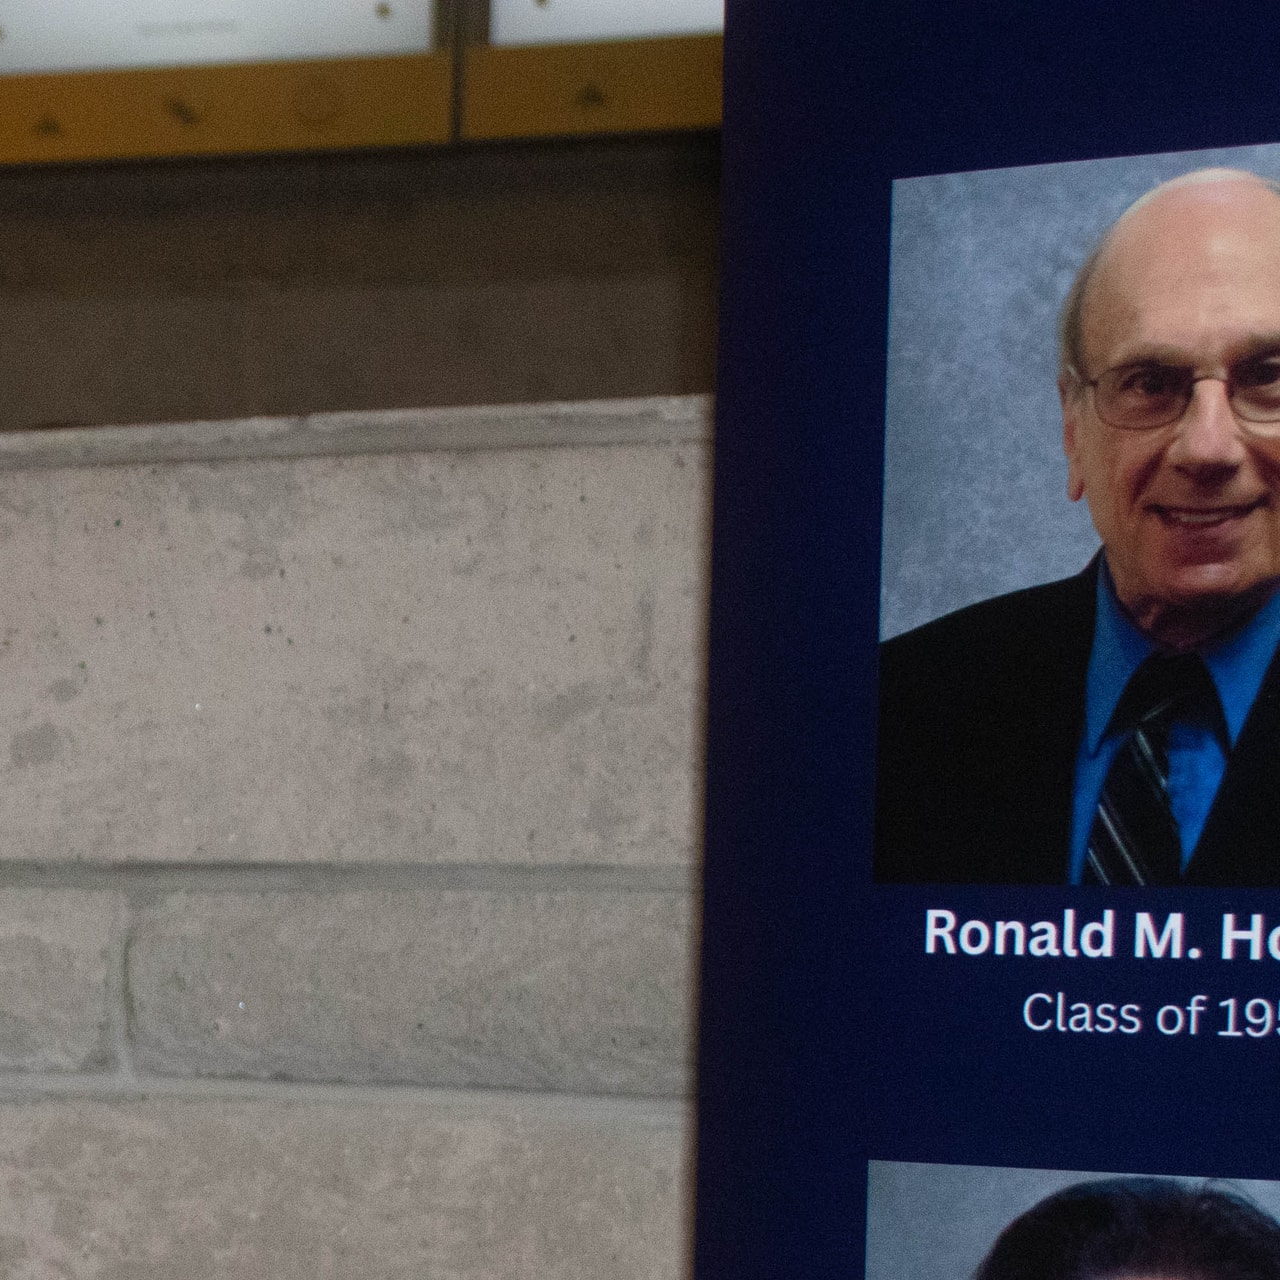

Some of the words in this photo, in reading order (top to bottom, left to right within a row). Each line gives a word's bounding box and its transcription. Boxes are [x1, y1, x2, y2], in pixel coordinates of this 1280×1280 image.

[925, 908, 1115, 957] Ronald
[1134, 911, 1203, 959] M.
[1023, 992, 1141, 1034] Class
[1156, 995, 1209, 1036] of
[1217, 998, 1280, 1037] 19
